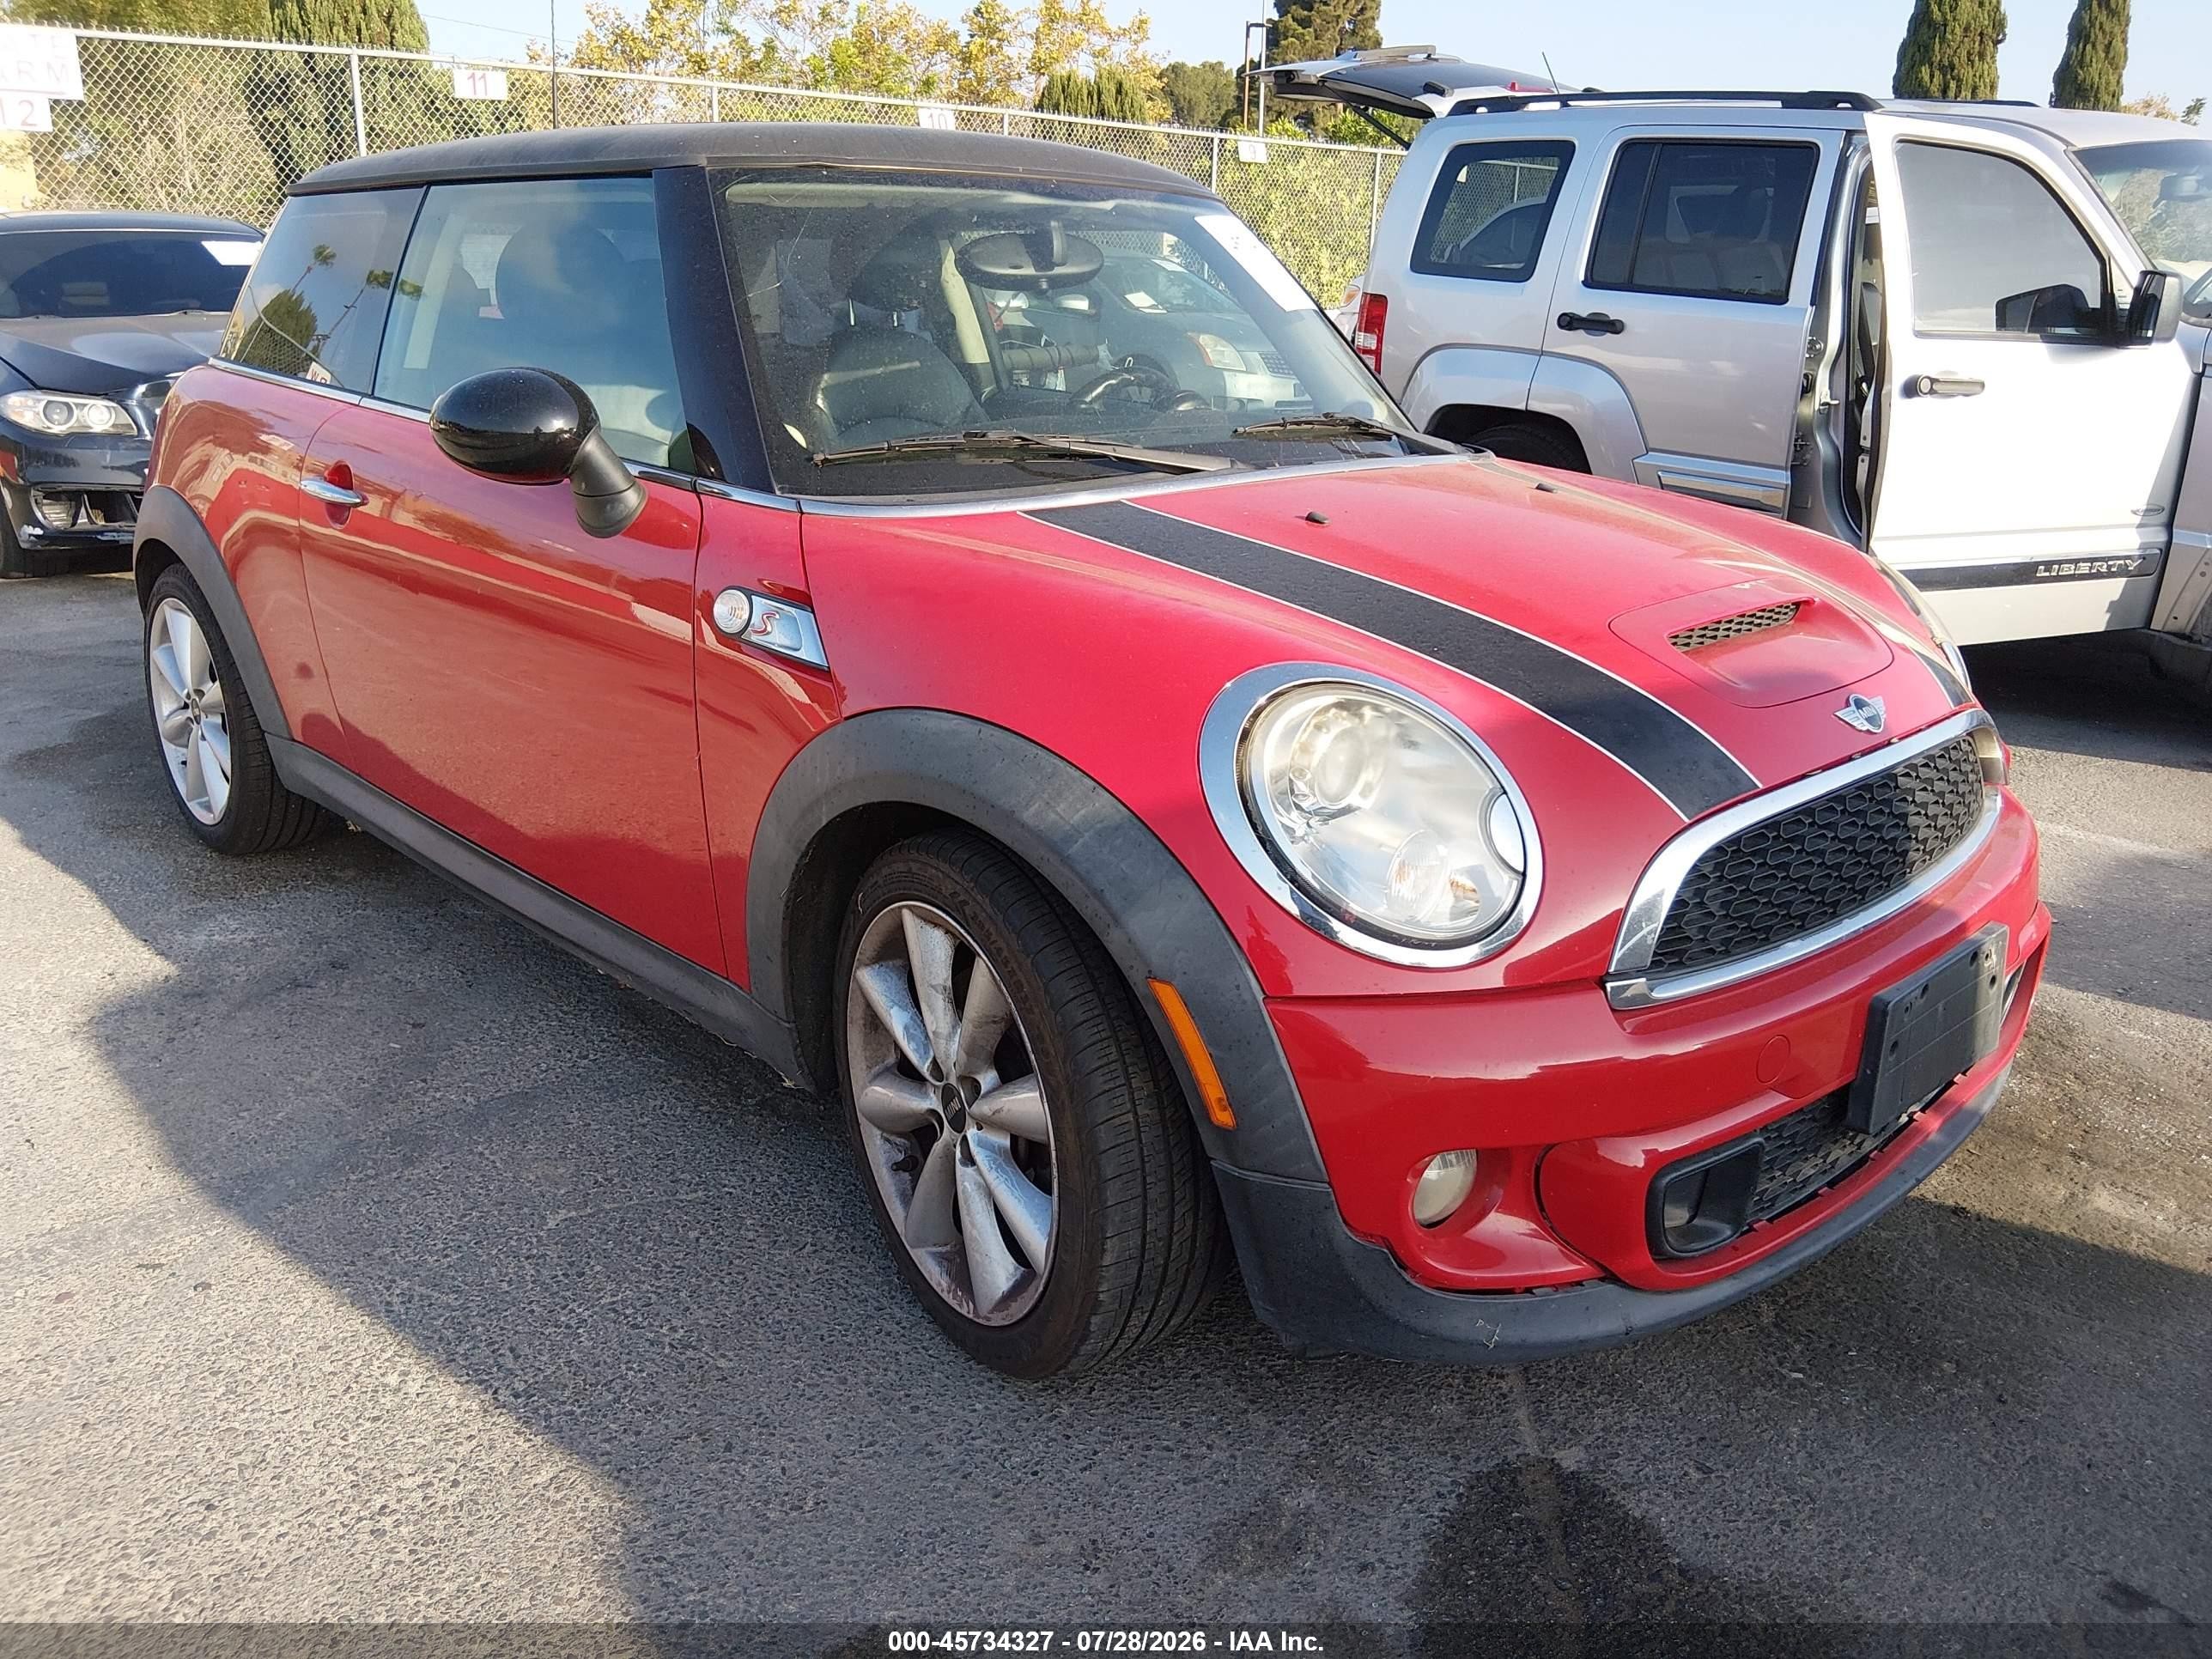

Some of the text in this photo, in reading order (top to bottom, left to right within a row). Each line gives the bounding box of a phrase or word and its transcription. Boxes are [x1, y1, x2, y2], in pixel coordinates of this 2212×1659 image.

[467, 72, 488, 96] 11
[2036, 558, 2145, 577] LIBERTY
[945, 1096, 962, 1120] MINI
